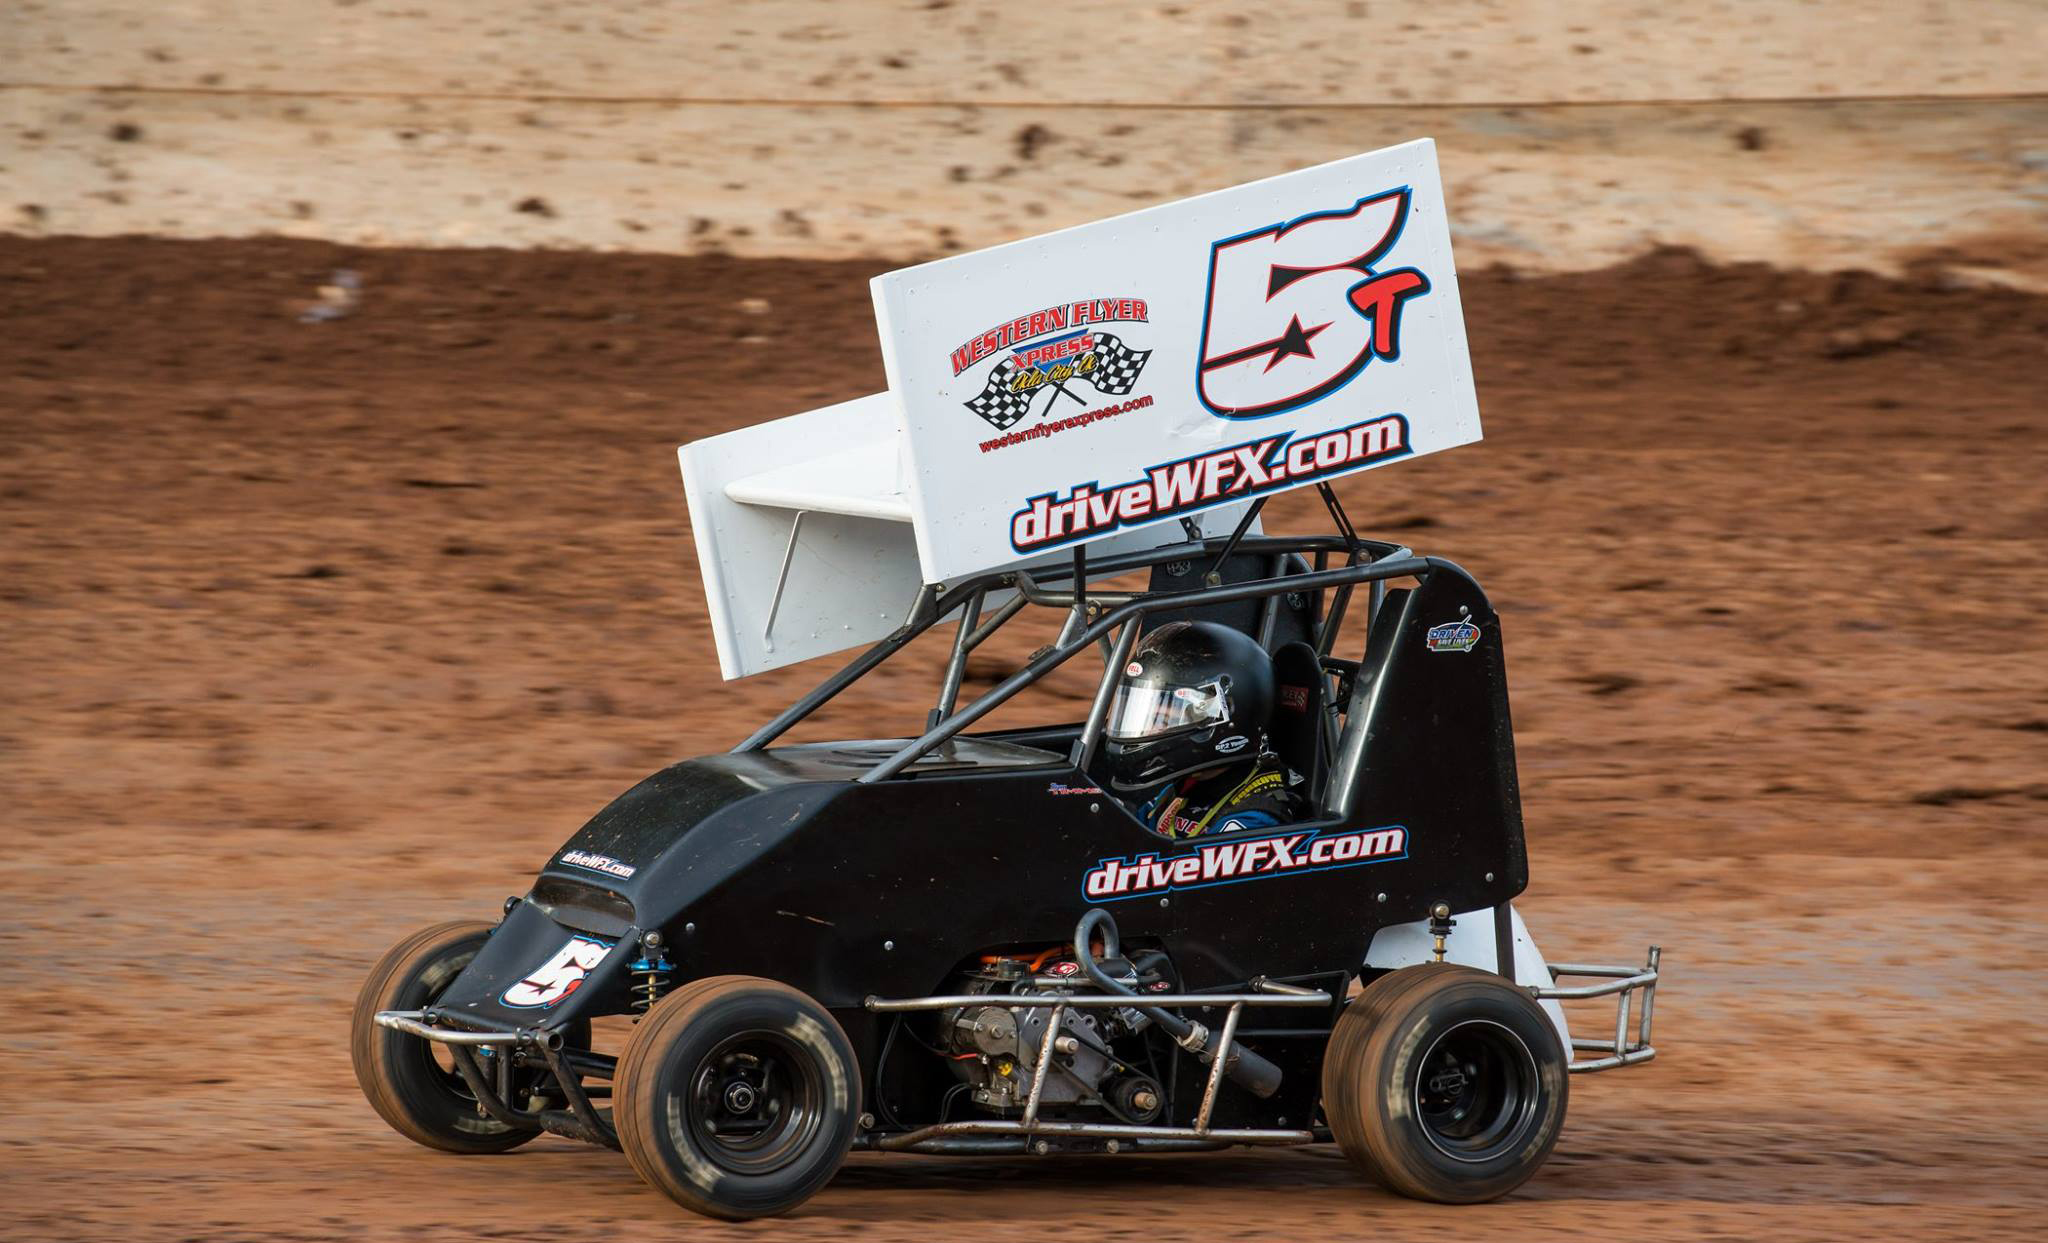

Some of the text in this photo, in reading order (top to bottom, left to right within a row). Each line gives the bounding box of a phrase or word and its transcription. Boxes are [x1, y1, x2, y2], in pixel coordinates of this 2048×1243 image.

[1199, 188, 1429, 418] 5 T
[951, 298, 1149, 377] WESTERN FLYER
[1011, 333, 1095, 370] XPRESS
[1044, 365, 1074, 383] City
[979, 395, 1153, 453] westernflyerexpress.com
[1012, 415, 1408, 547] driveWFX.com
[1429, 628, 1472, 640] DRIVEN
[561, 850, 636, 880] driveWFX.com
[1086, 827, 1405, 897] driveWFX.com
[499, 935, 613, 1008] 5
